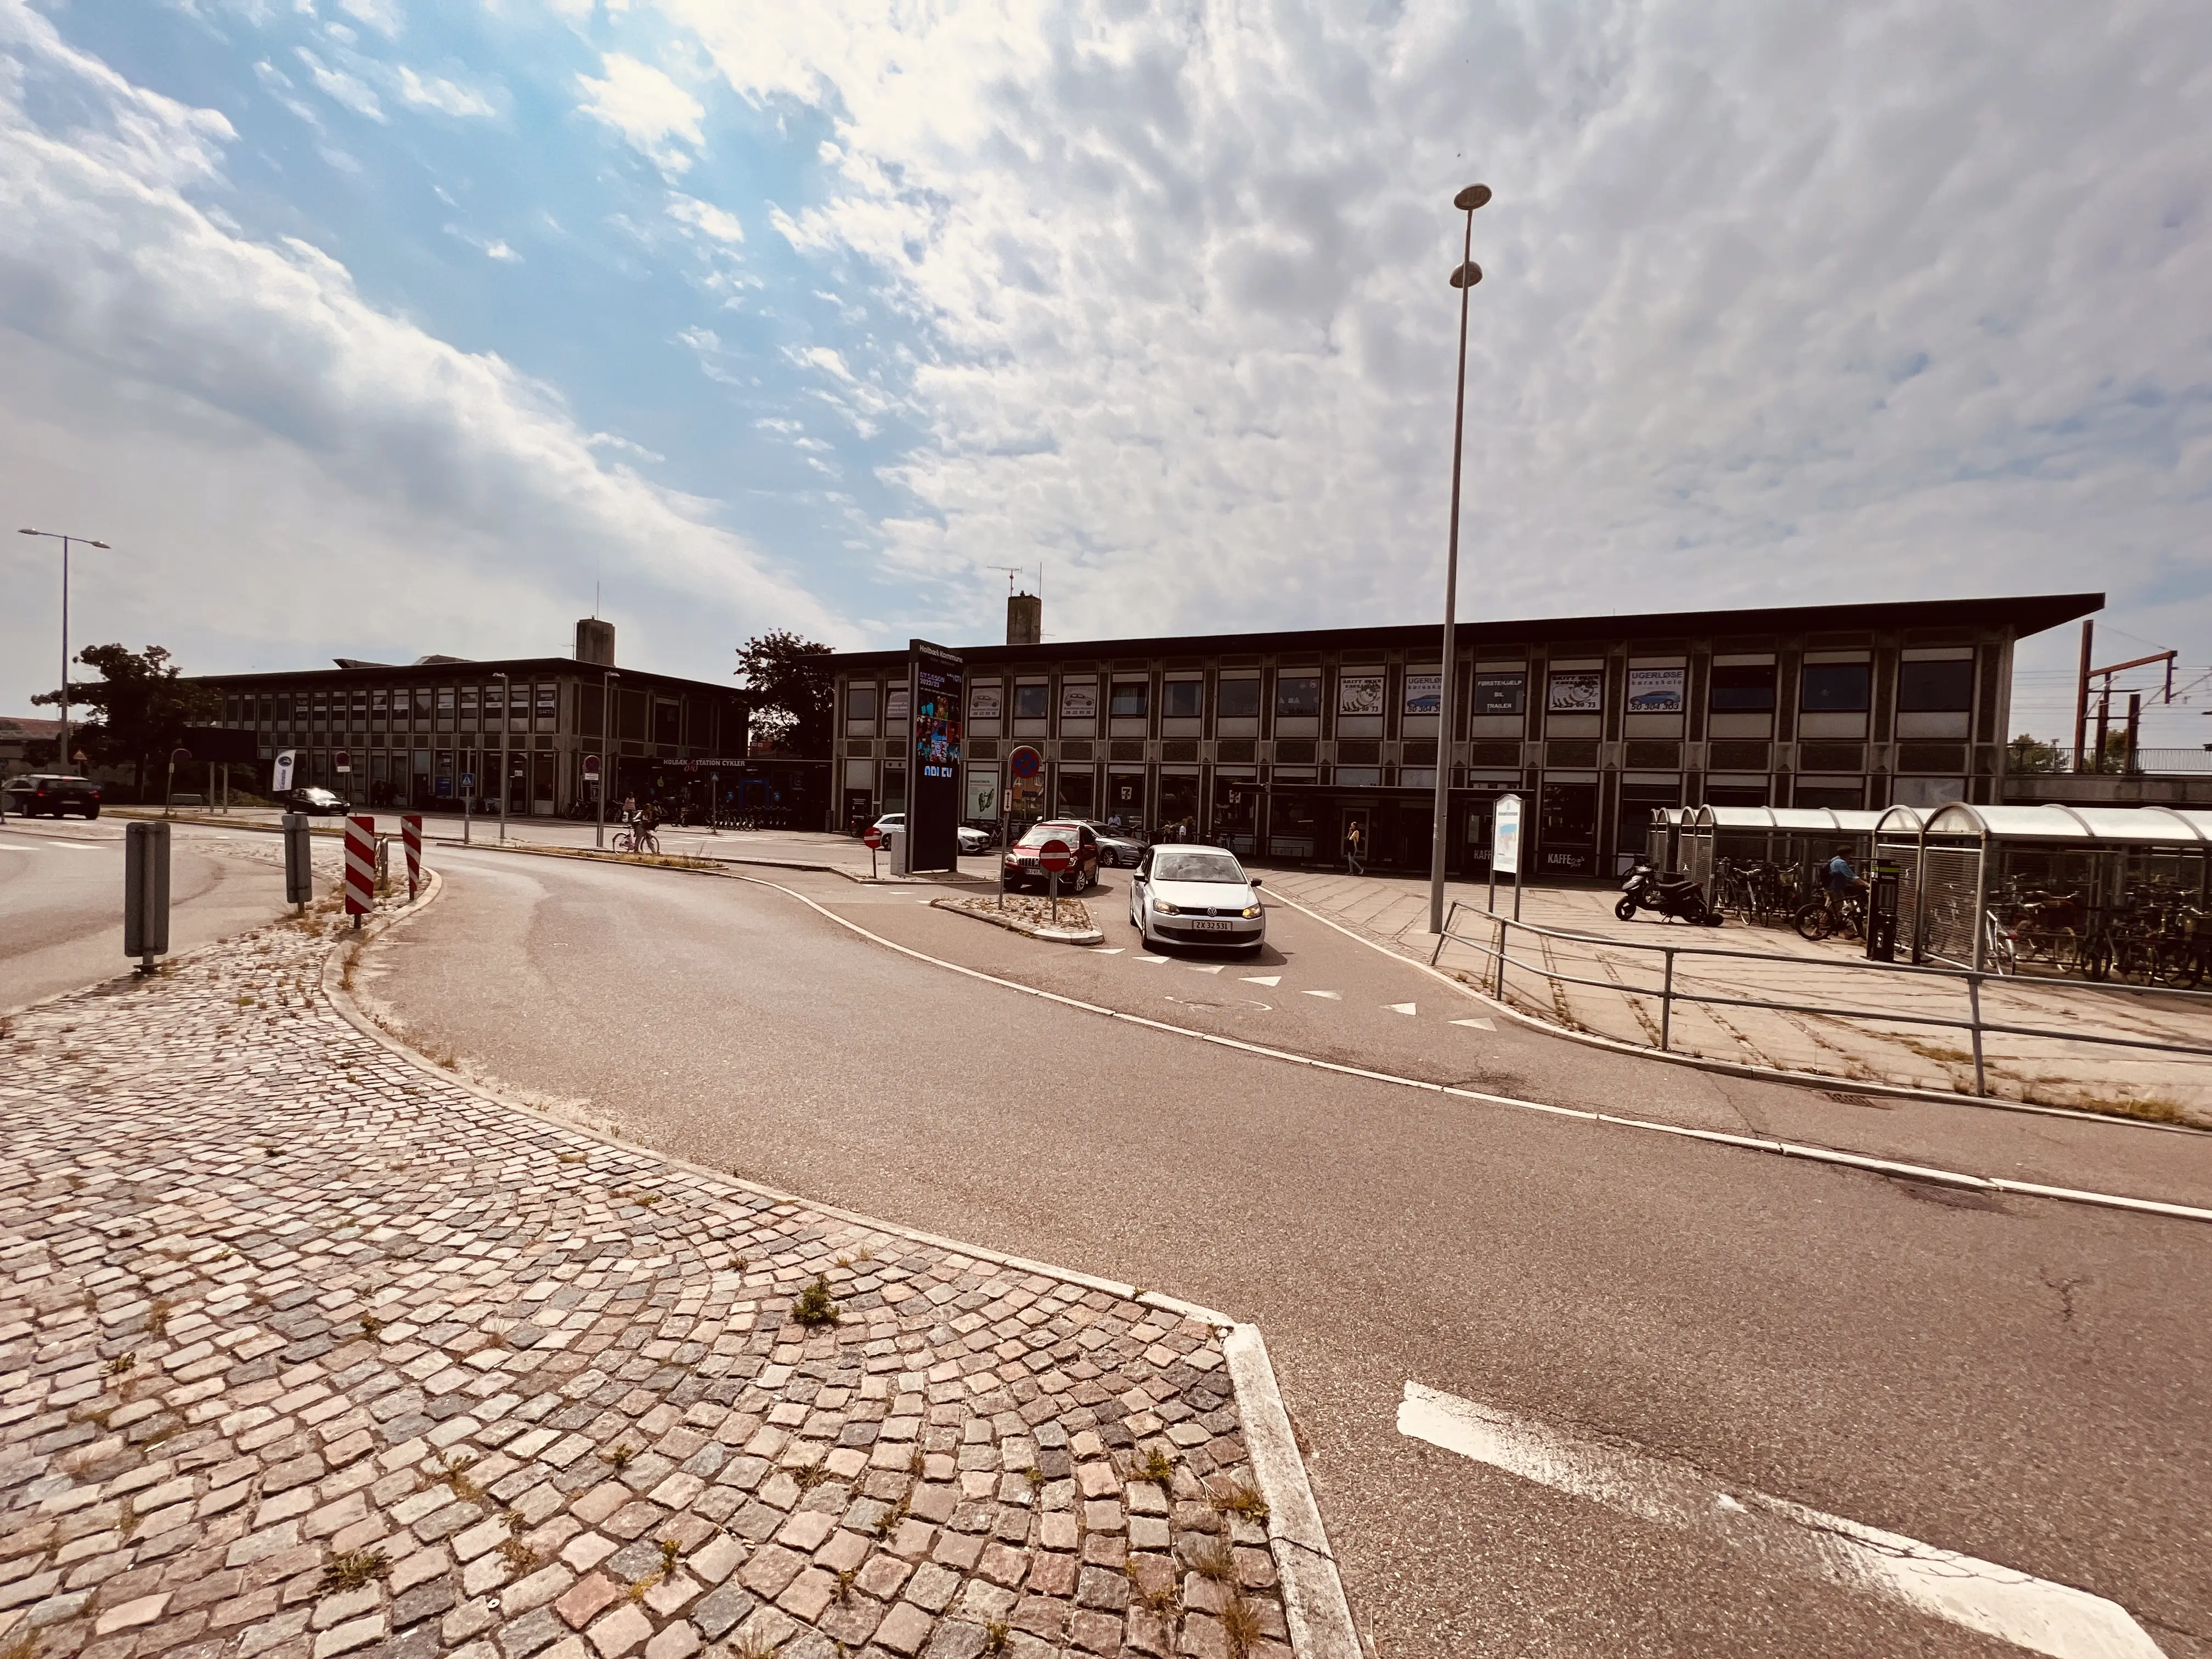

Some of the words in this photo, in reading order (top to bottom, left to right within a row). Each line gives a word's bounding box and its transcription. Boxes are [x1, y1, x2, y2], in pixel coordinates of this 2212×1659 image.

[940, 650, 963, 663] Kommune
[919, 678, 940, 687] 2022/23
[1548, 854, 1572, 864] KAFFE
